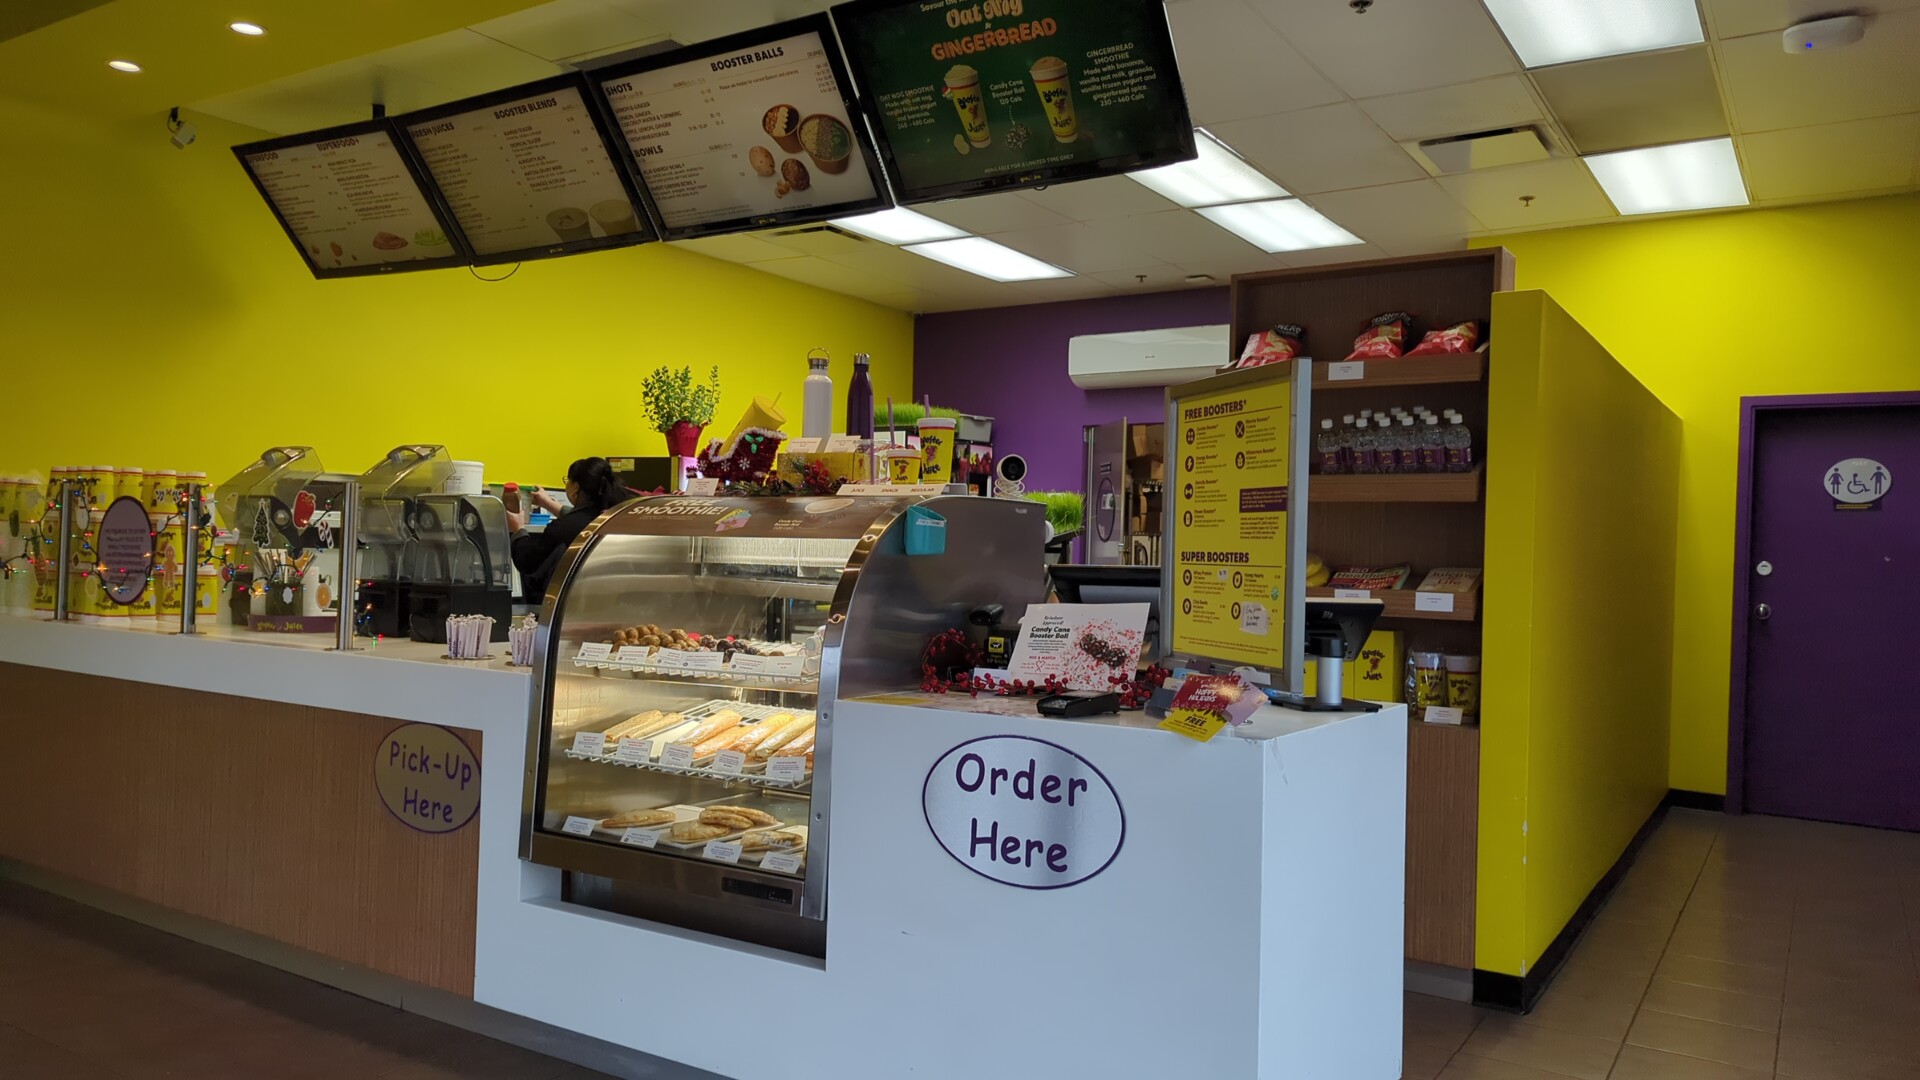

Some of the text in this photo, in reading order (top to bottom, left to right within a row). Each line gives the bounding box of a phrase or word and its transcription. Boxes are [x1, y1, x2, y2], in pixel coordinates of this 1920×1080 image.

[920, 1, 944, 12] Savour
[946, 4, 982, 28] Oat
[931, 17, 1058, 61] GINGERBREAD
[1086, 42, 1134, 58] GINGERBREAD
[710, 46, 784, 72] BOOSTER BALLS
[1094, 52, 1130, 65] SMOOTHIE
[1084, 68, 1101, 76] Made
[1102, 64, 1116, 72] with
[989, 82, 1008, 92] Candy
[1079, 76, 1100, 85] vanilla
[1080, 72, 1156, 94] vanilla frozen yogurt and
[606, 82, 632, 96] SHOTS
[905, 84, 935, 98] SMOOTHIE
[991, 90, 1014, 98] Booster
[1092, 87, 1130, 101] gingerbread
[494, 98, 558, 120] BOOSTER BLENDS
[634, 101, 650, 110] GINGER
[433, 122, 455, 135] JUICES
[634, 145, 664, 158] BOWLS
[1026, 158, 1046, 166] LIMITED
[1046, 156, 1060, 164] TIME
[1060, 153, 1074, 161] ONLY
[1184, 408, 1202, 420] FREE
[920, 435, 943, 448] Booster
[922, 464, 942, 475] Juice
[628, 506, 729, 515] SMOOTHIE!
[1181, 552, 1250, 564] SUPER BOOSTERS
[1362, 650, 1385, 659] Booster
[1184, 716, 1207, 726] FREE
[390, 740, 472, 791] Pick-Up
[956, 753, 1088, 806] Order
[404, 786, 452, 823] Here
[970, 818, 1068, 872] Here
